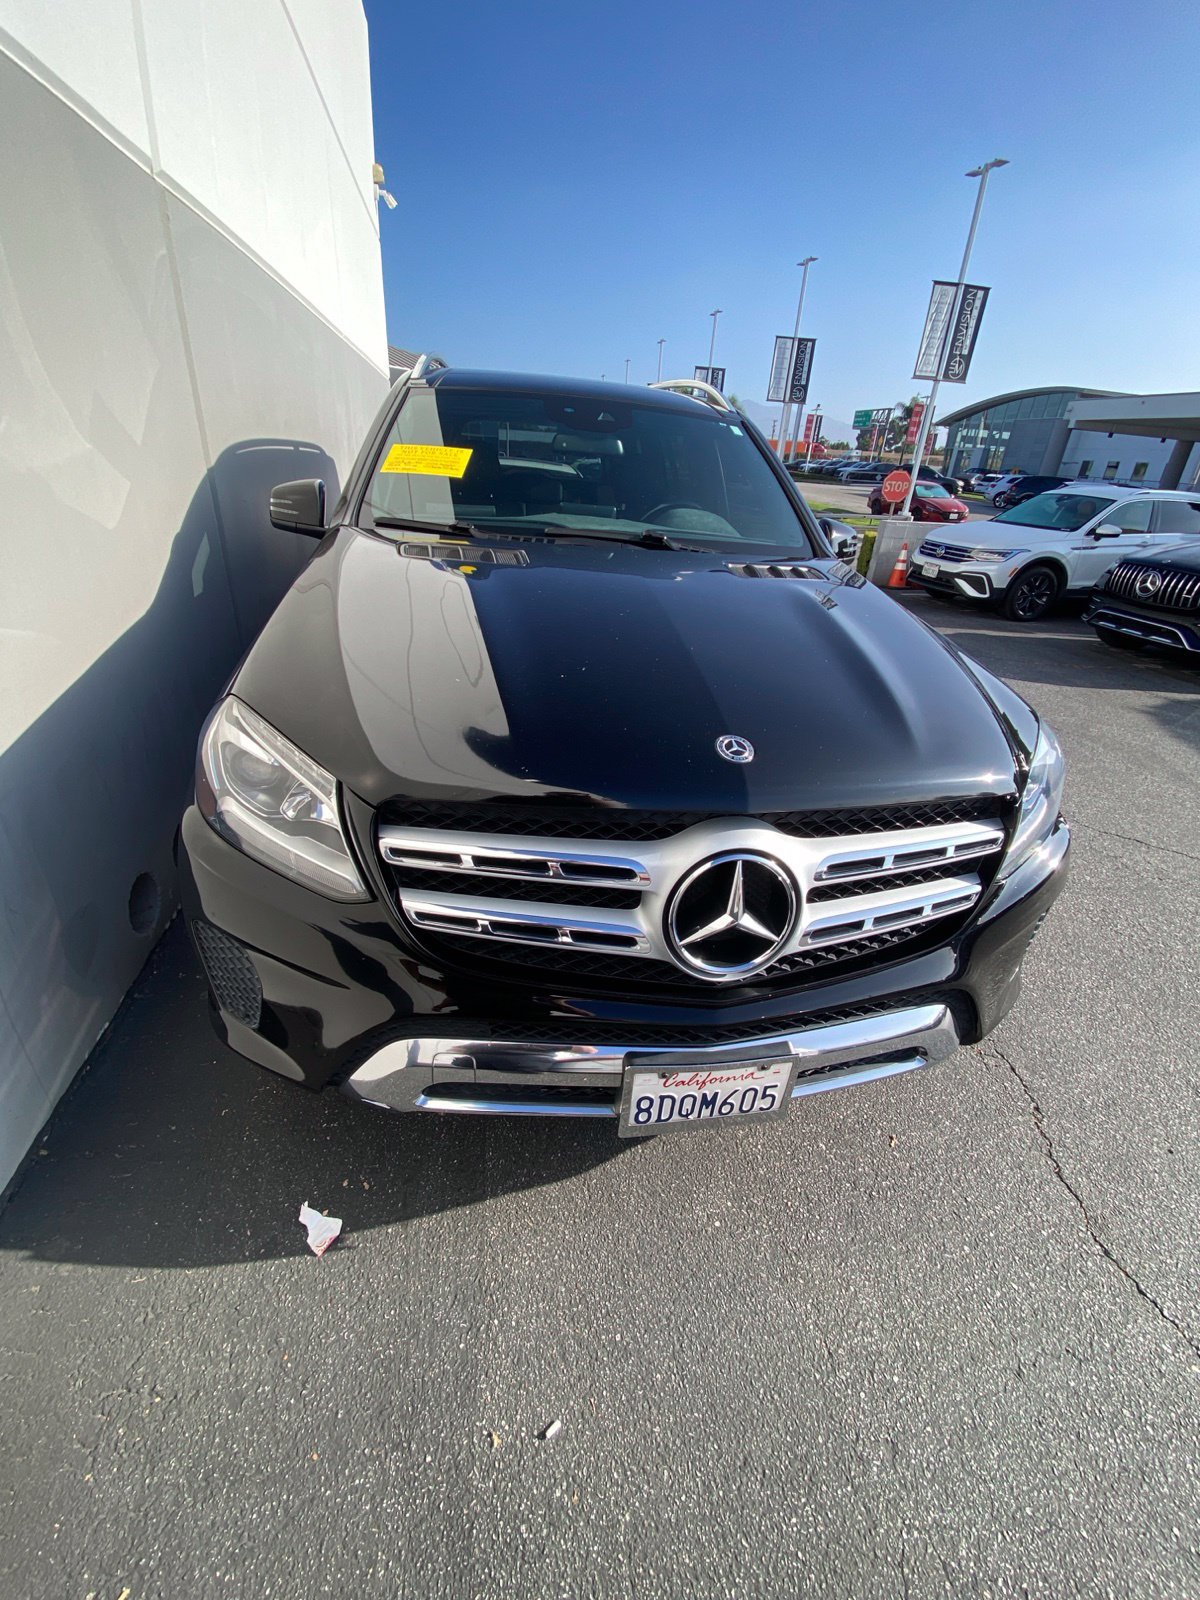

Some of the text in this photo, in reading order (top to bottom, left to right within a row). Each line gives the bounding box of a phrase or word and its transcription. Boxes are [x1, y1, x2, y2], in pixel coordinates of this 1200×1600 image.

[953, 288, 978, 354] ENVISION
[794, 340, 808, 384] ENVISION
[885, 480, 909, 493] STOP
[662, 1070, 764, 1091] California
[634, 1084, 779, 1125] 8DQM605
